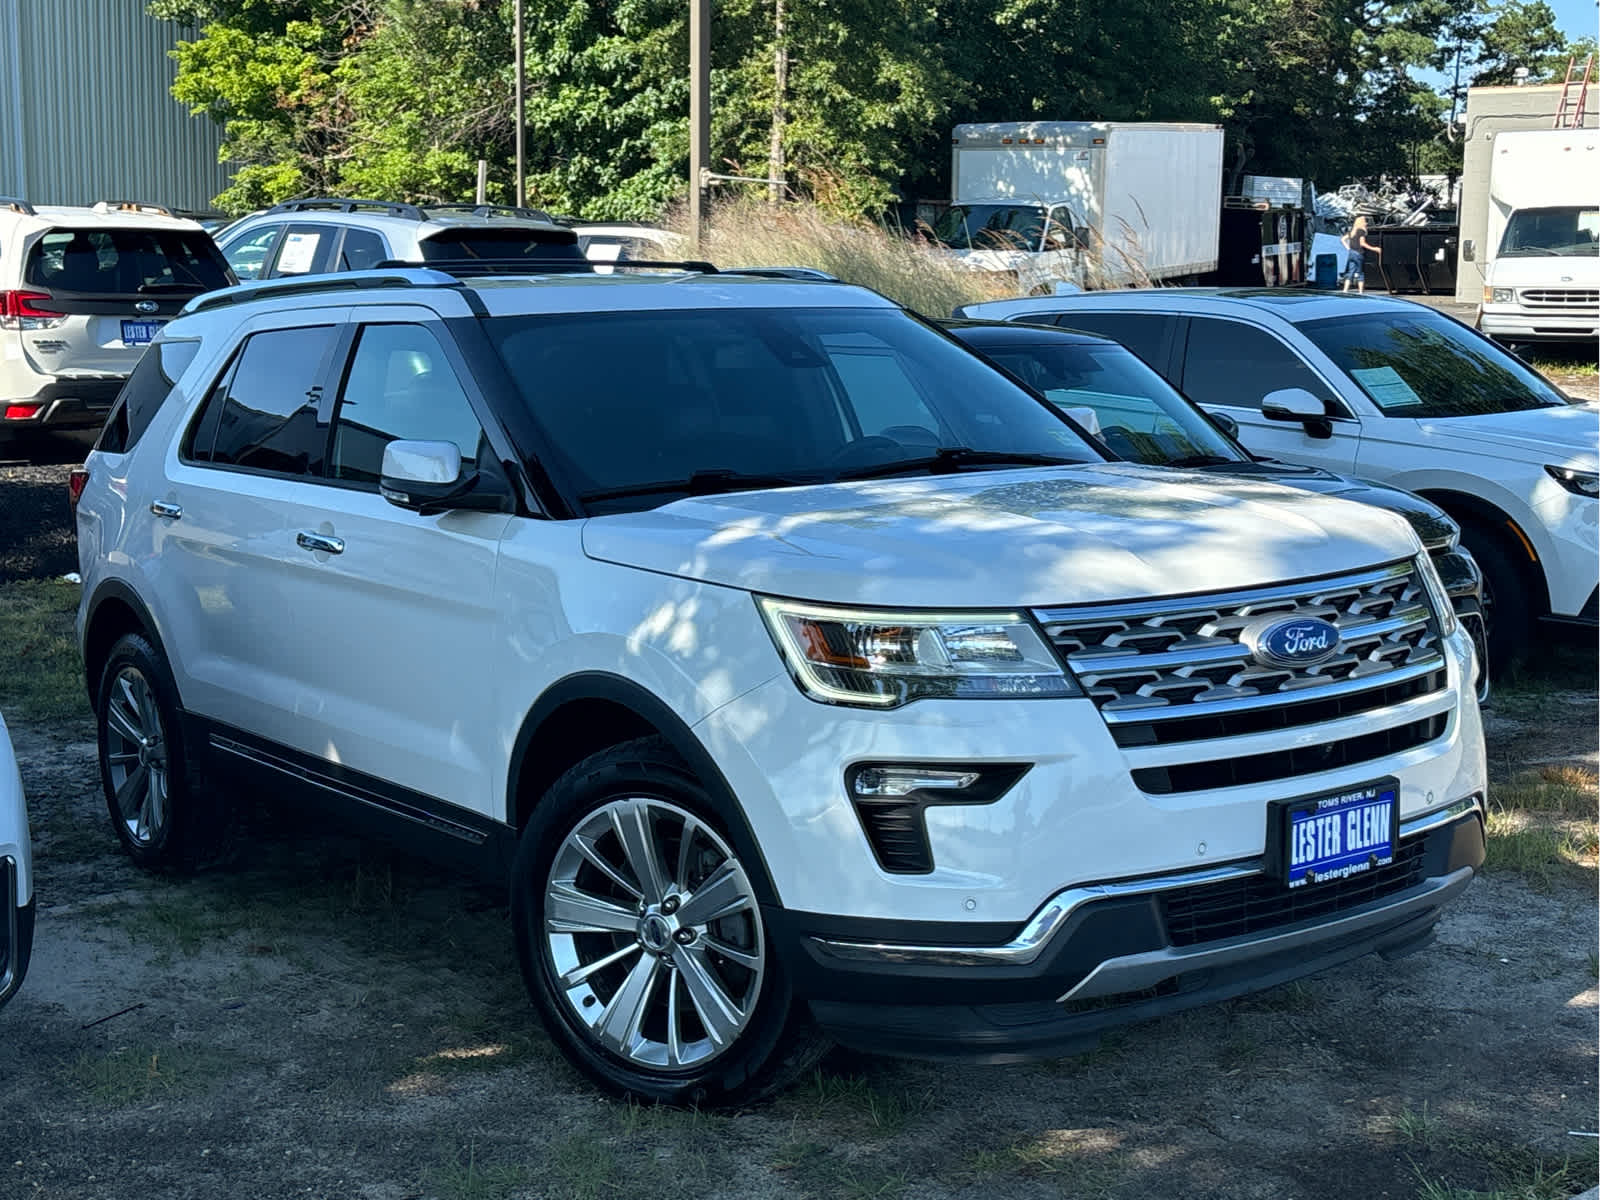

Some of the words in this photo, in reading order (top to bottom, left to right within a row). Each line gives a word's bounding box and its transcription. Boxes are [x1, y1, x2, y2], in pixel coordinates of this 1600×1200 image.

[123, 325, 148, 339] LESTER
[1284, 625, 1328, 654] Ford
[1318, 799, 1339, 809] TOMS
[1366, 789, 1376, 798] NJ
[1292, 814, 1341, 865] LESTER
[1347, 803, 1391, 851] GLENN
